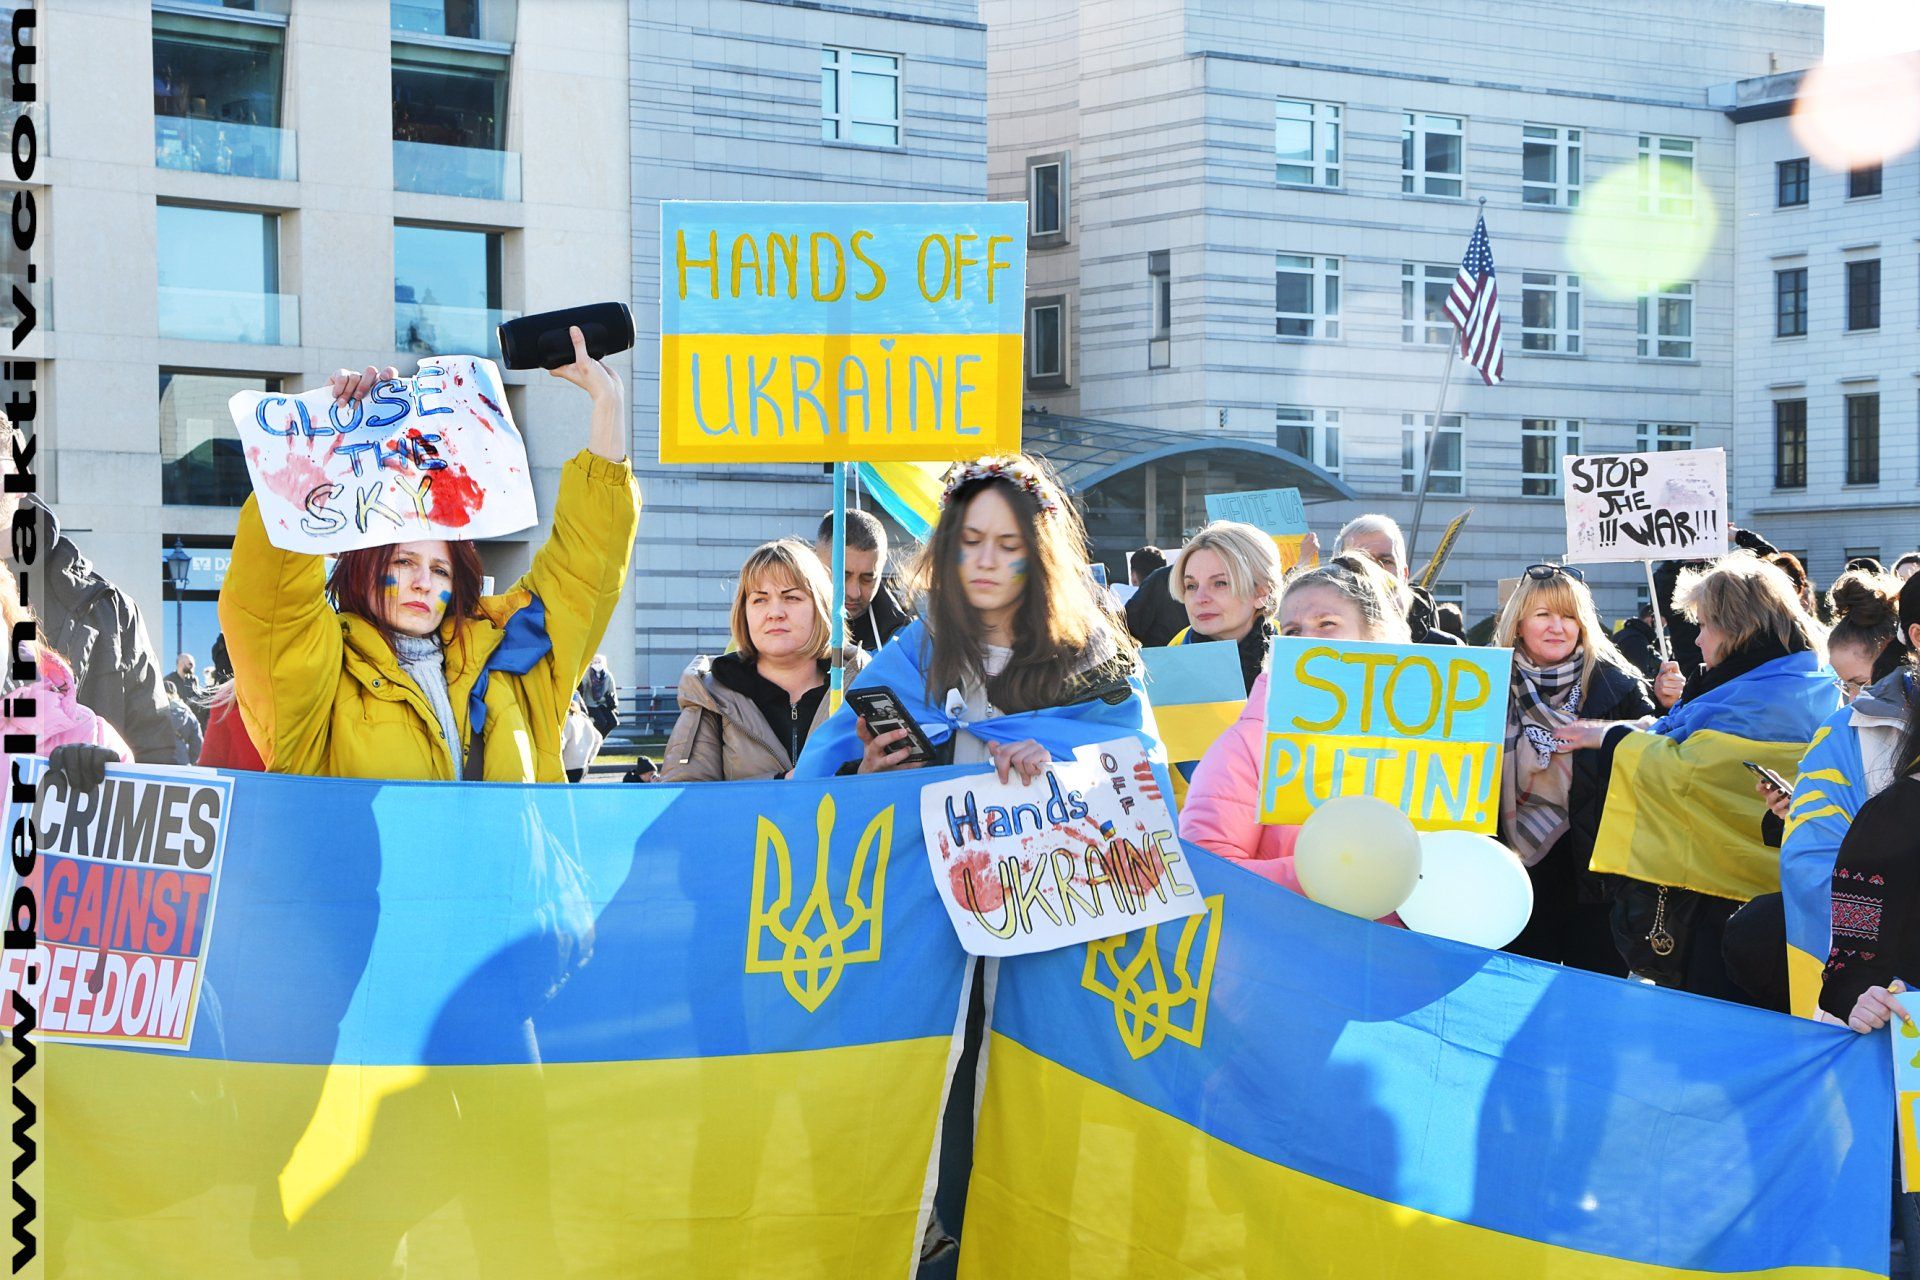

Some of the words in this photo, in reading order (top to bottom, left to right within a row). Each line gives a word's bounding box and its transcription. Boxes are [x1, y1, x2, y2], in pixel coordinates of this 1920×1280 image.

[676, 229, 887, 302] HANDS
[917, 233, 1014, 304] OFF
[256, 366, 454, 437] CLOSE
[333, 433, 448, 478] THE
[1571, 457, 1649, 494] STOP
[300, 475, 433, 537] SKY
[1292, 646, 1491, 738] STOP
[30, 768, 221, 870] CRIMES
[945, 770, 1089, 847] Hands
[1265, 738, 1497, 824] PUTIN!
[0, 944, 198, 1039] FREEDOM
